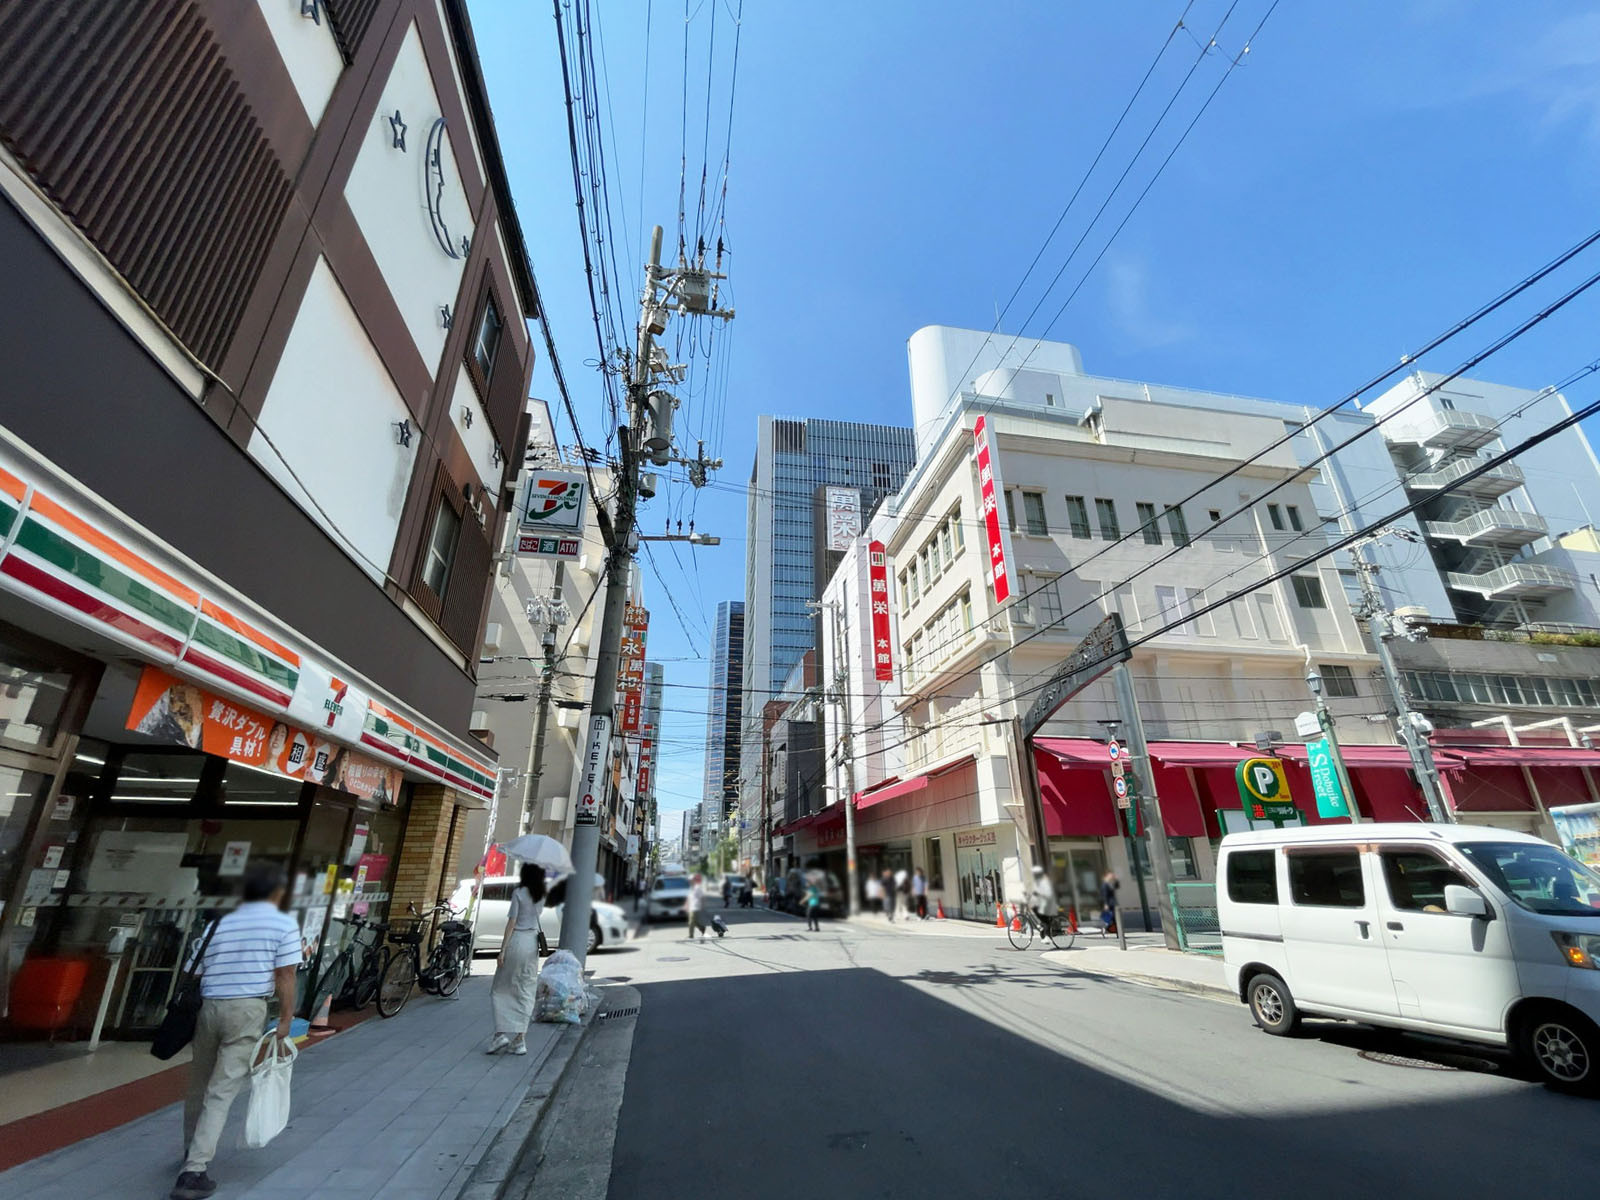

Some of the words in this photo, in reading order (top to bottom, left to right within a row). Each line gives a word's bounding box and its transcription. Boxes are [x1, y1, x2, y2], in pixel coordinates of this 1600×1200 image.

[543, 541, 556, 552] 酒
[560, 542, 577, 553] ATM
[208, 699, 266, 741] 贅沢ダブル
[289, 744, 304, 763] 相
[1253, 766, 1274, 794] P
